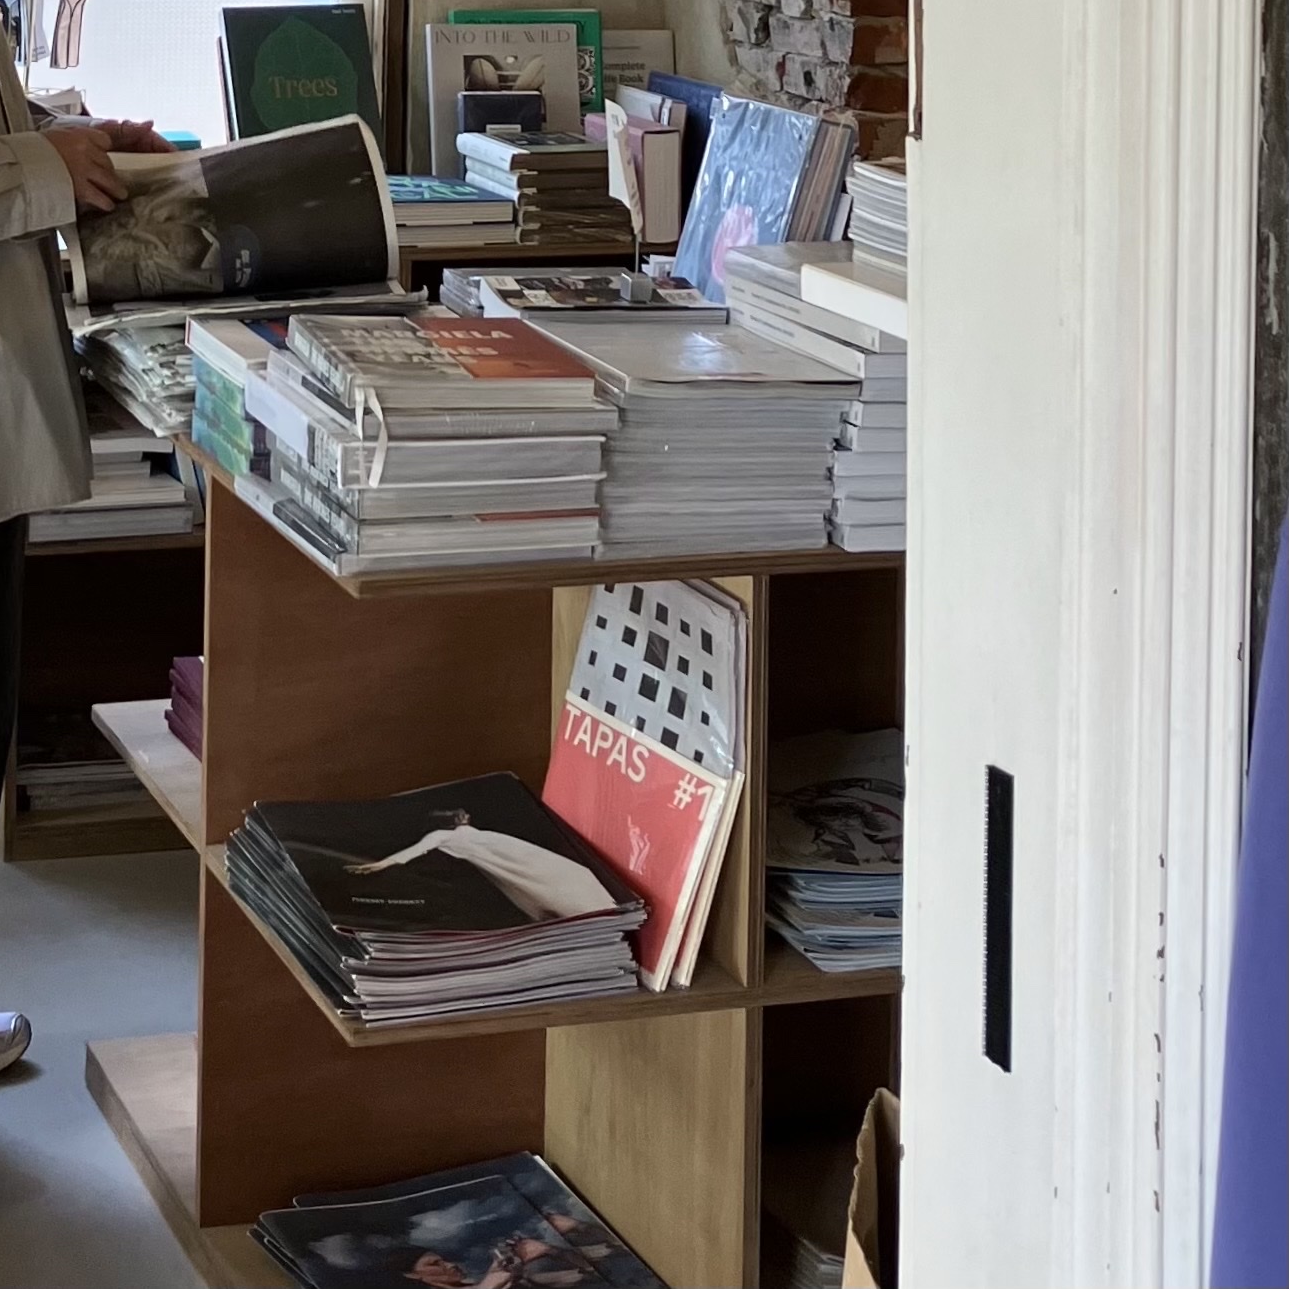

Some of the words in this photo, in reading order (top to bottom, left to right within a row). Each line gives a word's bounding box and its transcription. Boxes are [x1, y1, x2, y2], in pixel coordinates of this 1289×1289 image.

[435, 29, 476, 45] INTO
[485, 29, 517, 45] THE
[525, 28, 571, 44] WILD
[603, 61, 646, 72] omplete
[268, 75, 338, 99] Trees
[565, 703, 650, 783] TAPAS
[674, 773, 716, 822] #1
